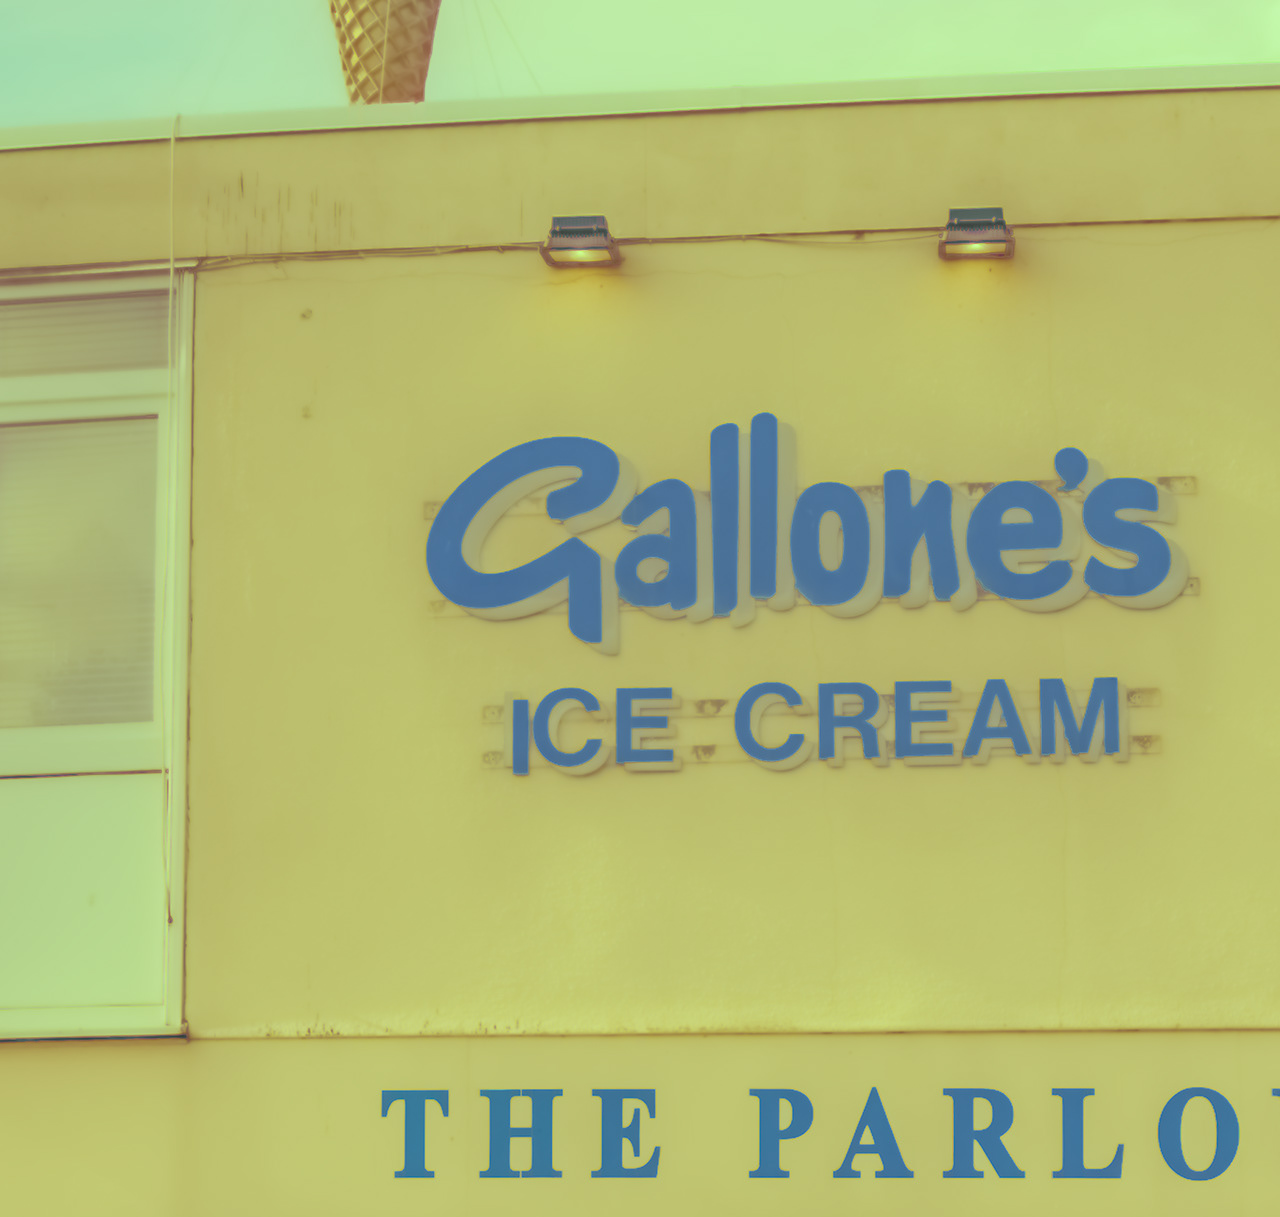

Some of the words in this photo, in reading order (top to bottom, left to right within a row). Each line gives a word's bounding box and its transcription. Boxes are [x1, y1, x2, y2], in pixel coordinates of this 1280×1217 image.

[426, 411, 1172, 644] Gallone's
[512, 686, 675, 776] ICE
[734, 676, 1120, 763] CREAM
[381, 1089, 660, 1179] THE
